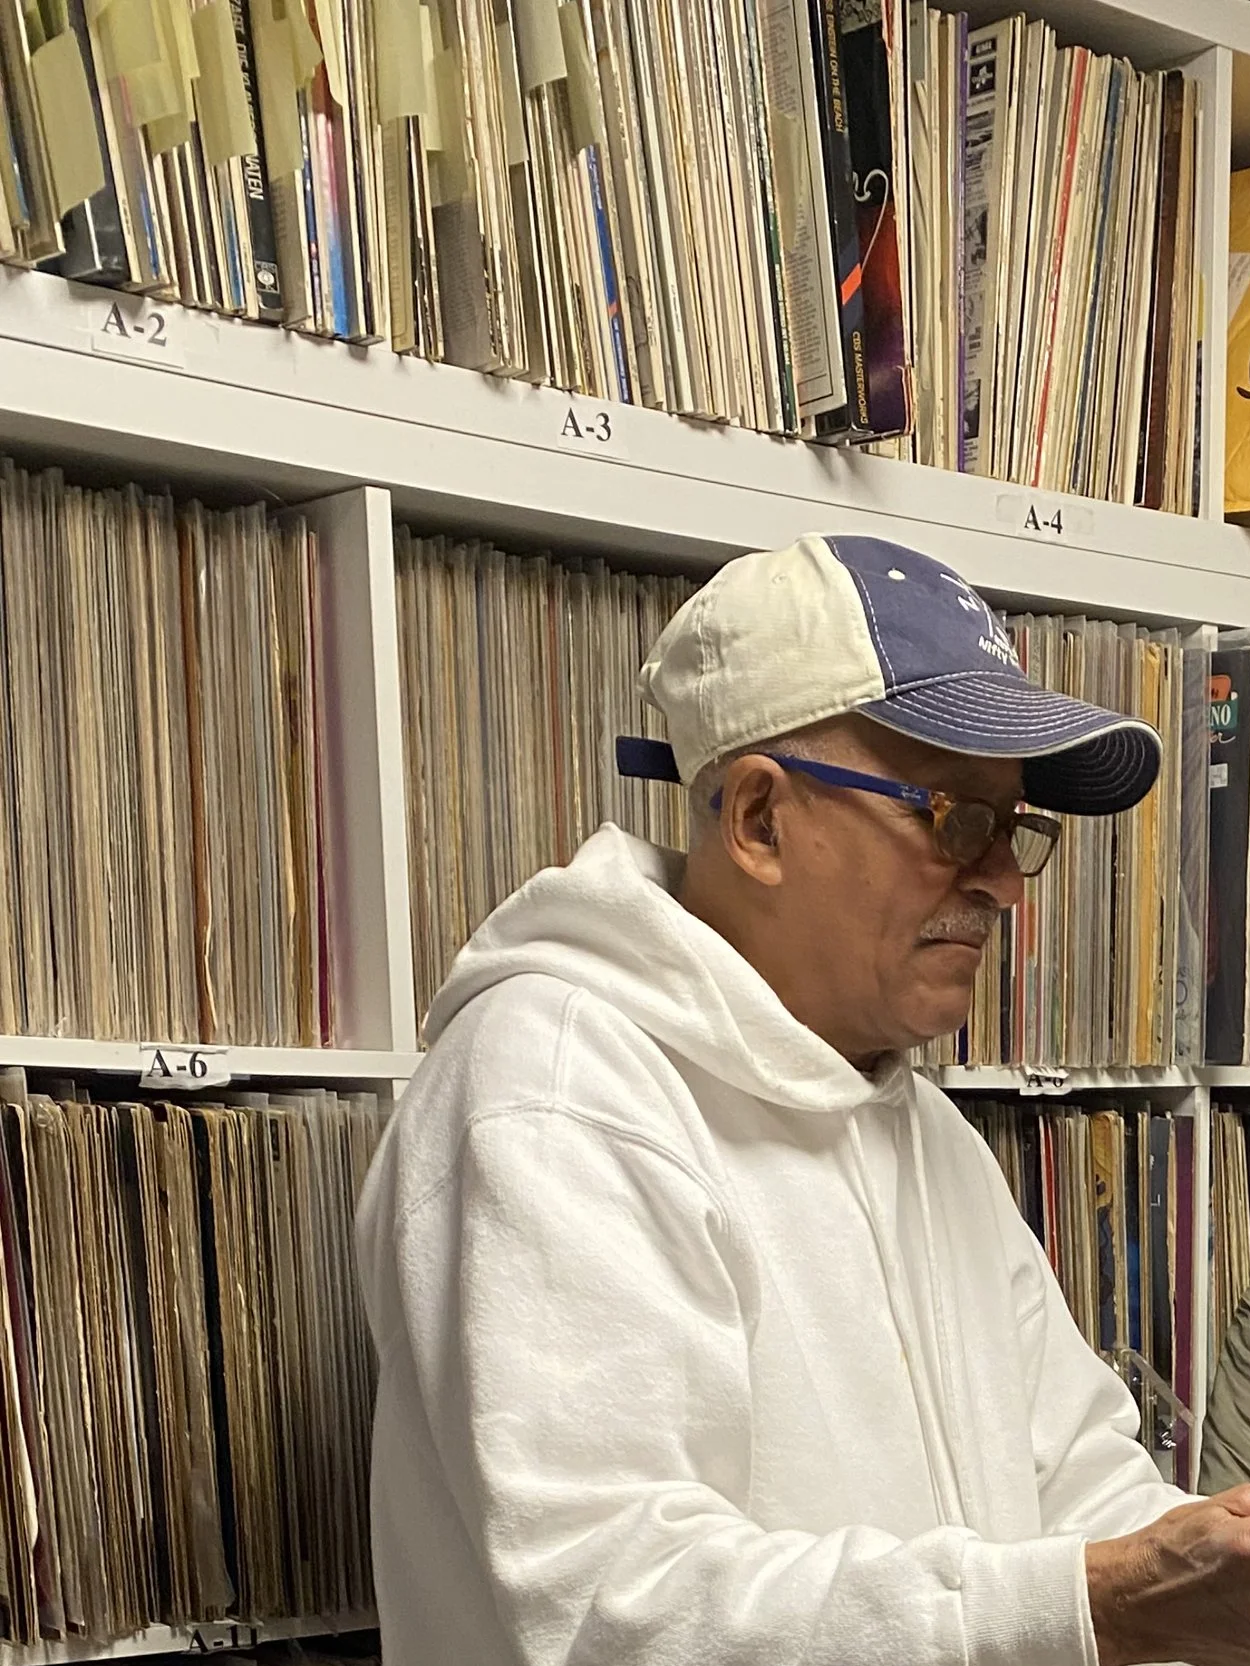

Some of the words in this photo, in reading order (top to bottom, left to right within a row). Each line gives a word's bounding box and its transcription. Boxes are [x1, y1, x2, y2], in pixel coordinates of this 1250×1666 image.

[829, 59, 838, 75] ON
[832, 98, 844, 132] BEACH
[101, 303, 168, 348] A-2
[852, 331, 862, 350] CBS
[852, 352, 870, 424] MASTERWORKS
[560, 407, 613, 443] A-3
[1023, 504, 1063, 535] A-4
[146, 1047, 208, 1079] A-6
[188, 1624, 258, 1654] A-11
